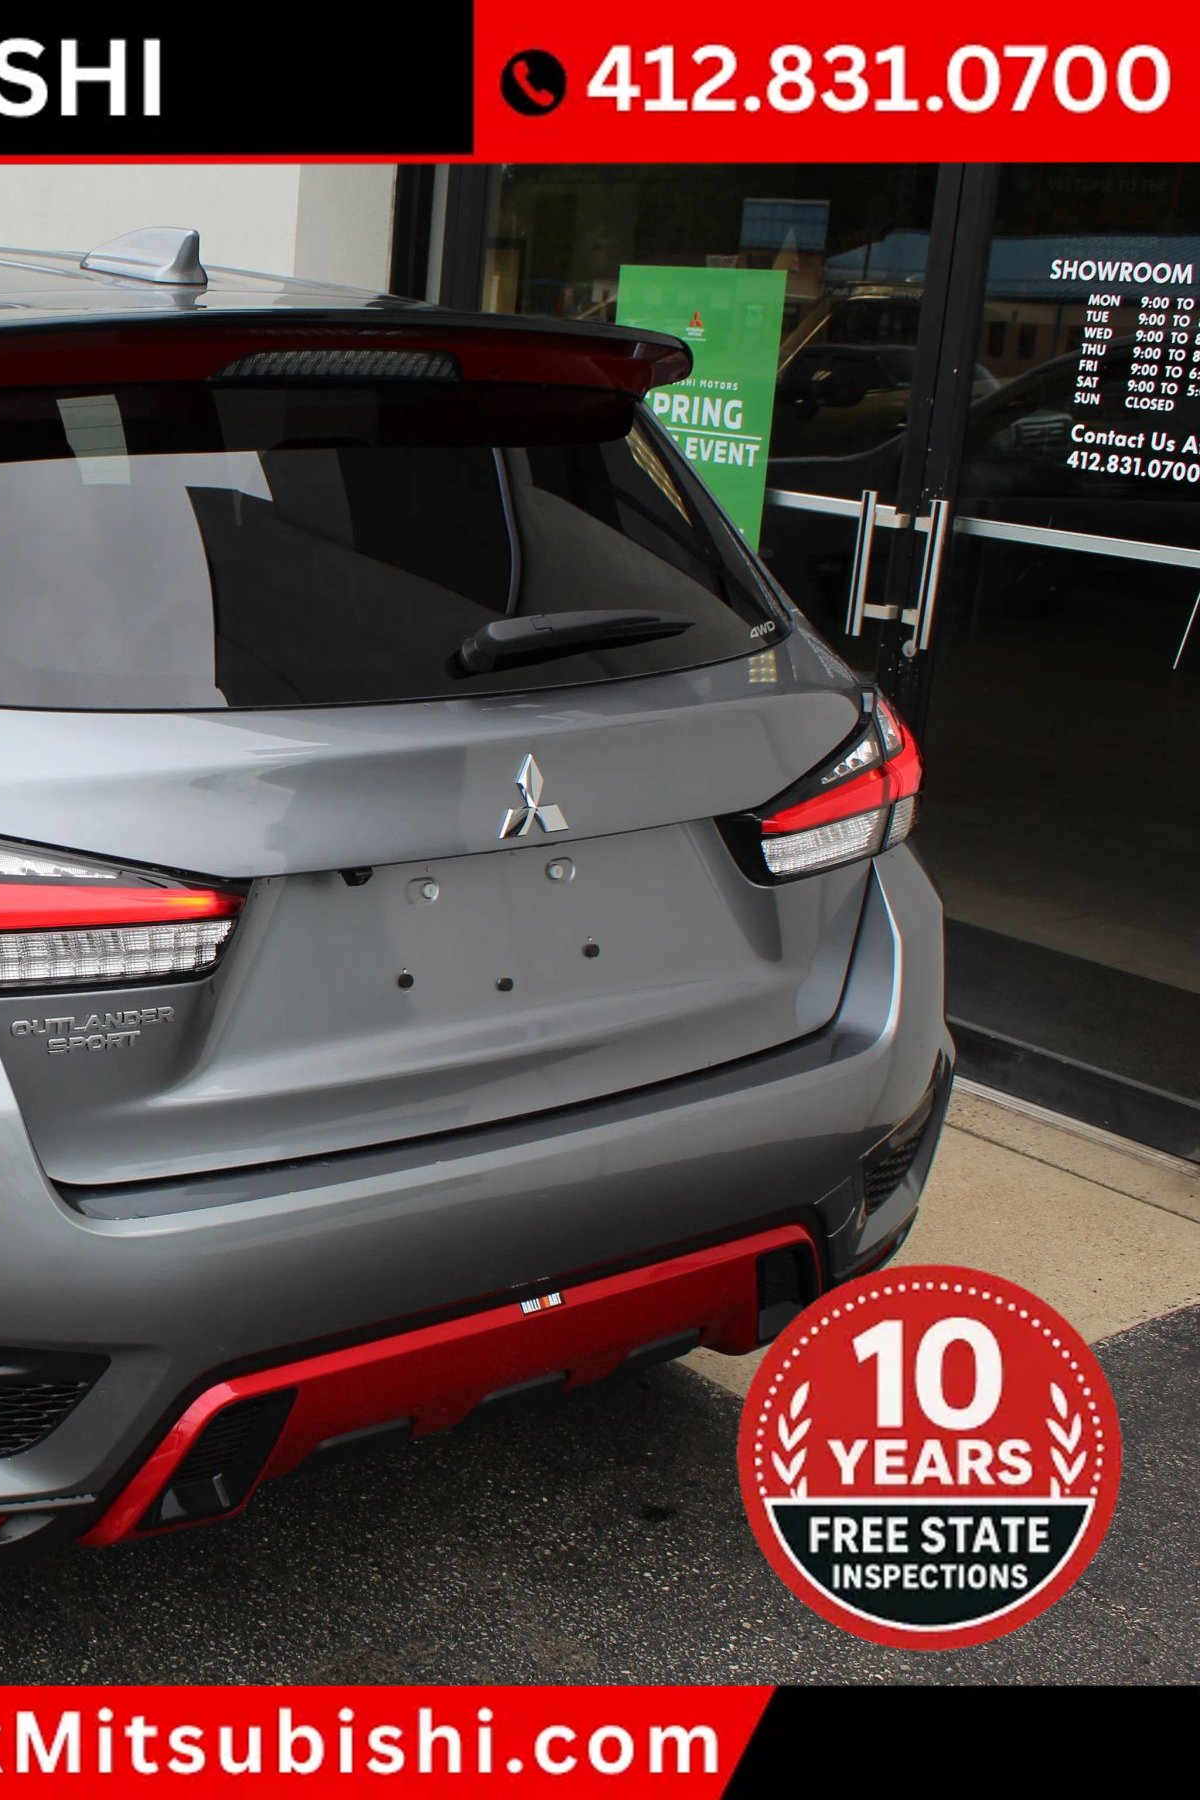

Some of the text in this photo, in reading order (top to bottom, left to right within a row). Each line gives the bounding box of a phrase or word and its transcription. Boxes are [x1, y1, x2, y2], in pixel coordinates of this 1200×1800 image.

[1050, 259, 1193, 284] SHOWROOM
[1088, 294, 1194, 310] MON 9:00 TO
[1086, 310, 1190, 327] TUE 9:00 TO
[1084, 327, 1112, 340] WED
[1135, 330, 1164, 343] 9:00
[1170, 332, 1188, 344] TO
[1081, 343, 1106, 356] THU
[1133, 346, 1161, 359] 9:00
[1168, 349, 1186, 361] TO
[1078, 360, 1098, 372] FRI
[1130, 363, 1158, 377] 9:00
[1165, 365, 1183, 378] TO
[700, 379, 738, 391] MOTORS
[1076, 376, 1200, 397] SAT 9:00 TO 5:
[644, 392, 743, 430] PRING
[1074, 392, 1174, 411] SUN CLOSED
[1071, 424, 1145, 449] Contact
[1151, 432, 1176, 452] Us
[685, 436, 760, 467] EVENT
[1066, 451, 1200, 483] 412.831.0700
[749, 620, 776, 639] 4WD
[11, 1006, 176, 1037] OUTLANDER
[47, 1030, 141, 1055] SPORT
